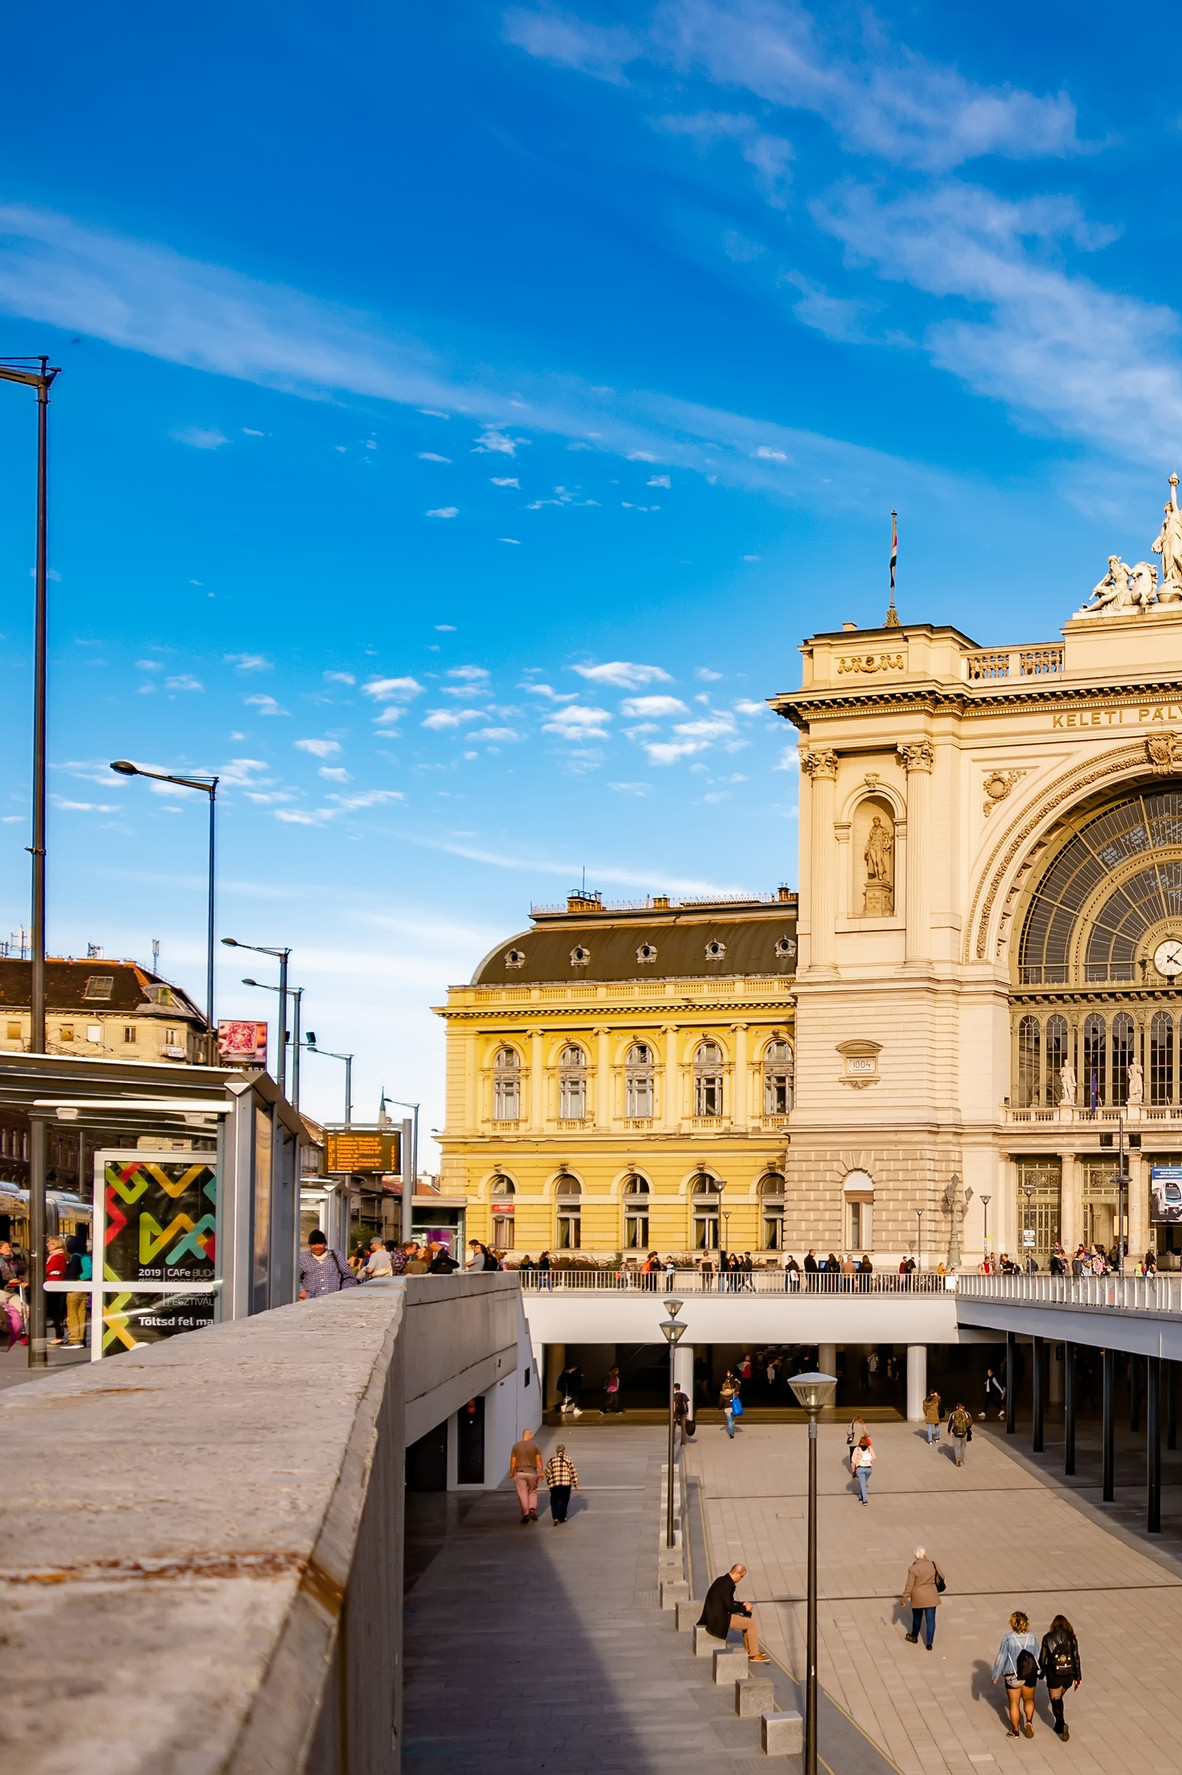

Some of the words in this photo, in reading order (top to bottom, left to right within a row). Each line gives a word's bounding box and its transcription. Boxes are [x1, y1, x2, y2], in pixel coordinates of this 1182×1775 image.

[1052, 710, 1123, 728] KELETI
[138, 1268, 161, 1277] 2019
[167, 1268, 191, 1277] CAFe
[167, 1296, 215, 1306] FESZTIVÁL
[138, 1316, 175, 1326] Töltsd
[177, 1316, 194, 1326] fel
